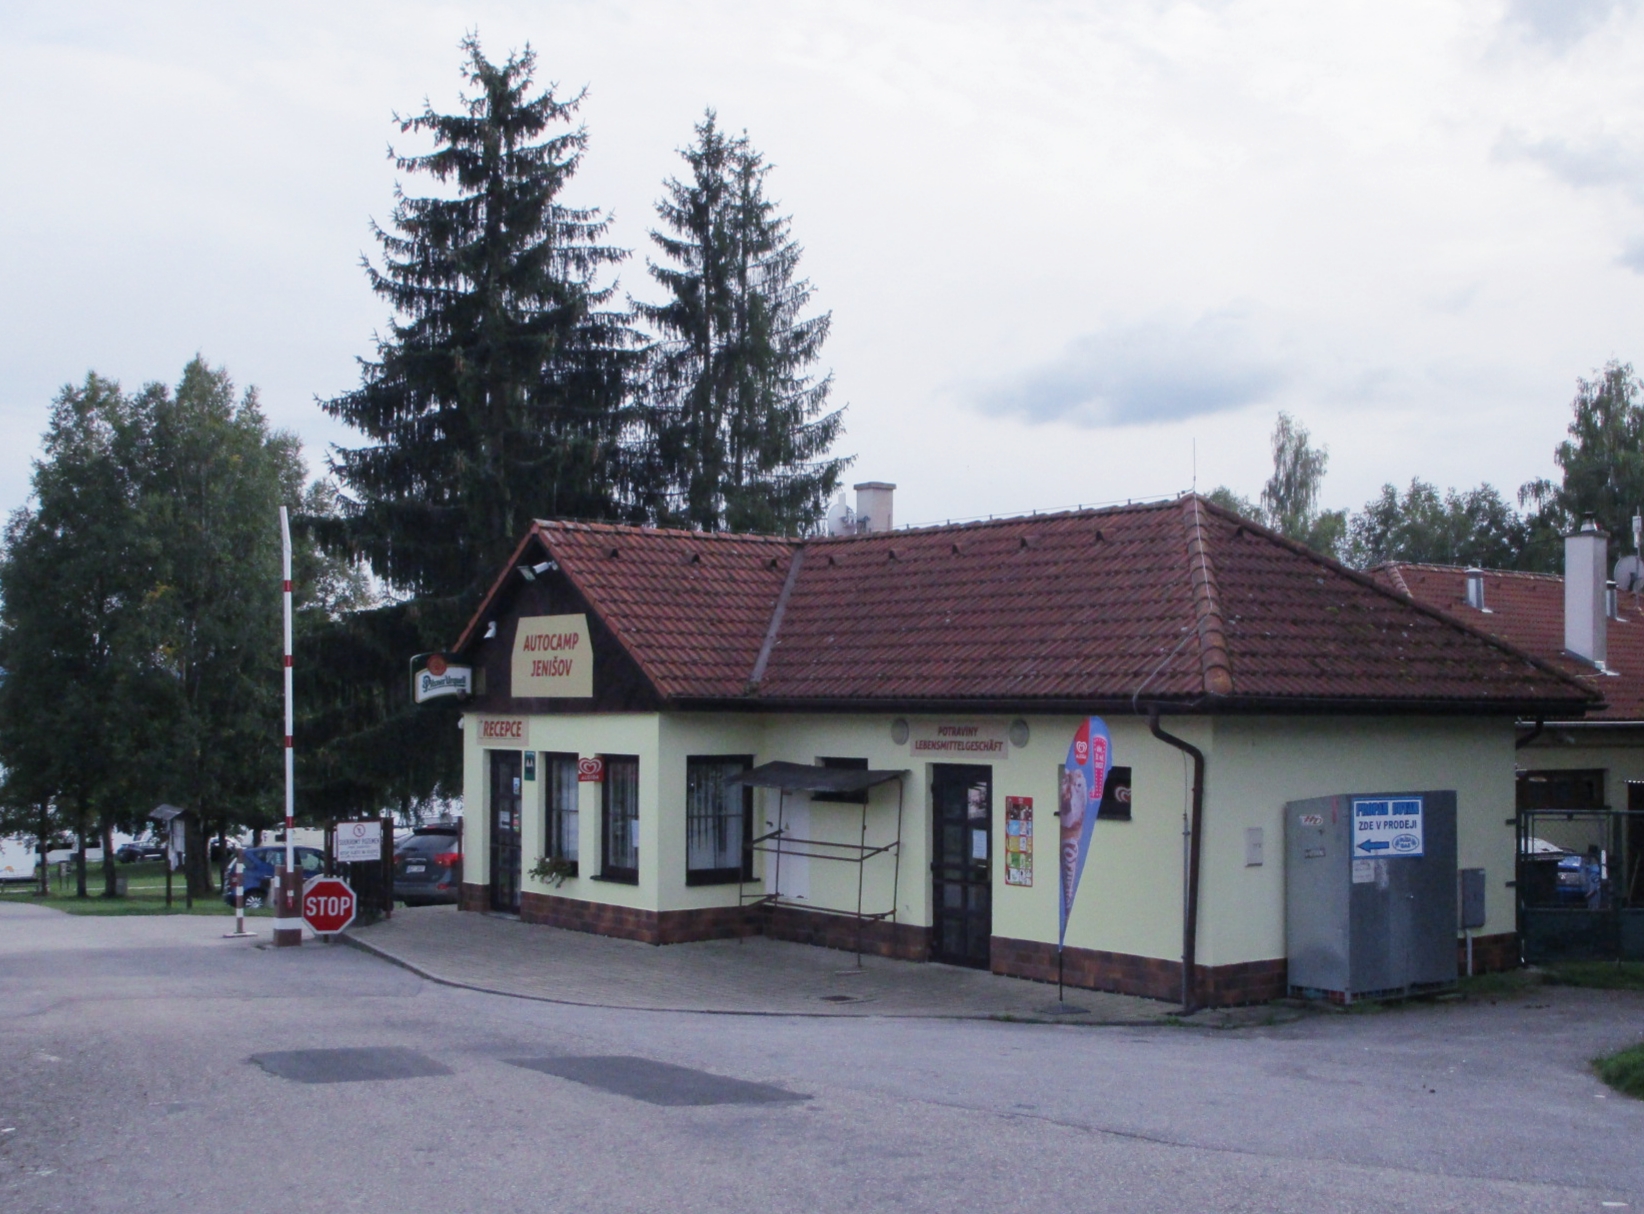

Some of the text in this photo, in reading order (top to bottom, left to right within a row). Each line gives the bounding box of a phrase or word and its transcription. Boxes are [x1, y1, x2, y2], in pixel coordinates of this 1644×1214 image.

[523, 633, 579, 651] AUTOCAMP
[531, 656, 573, 677] JENIŠOV
[483, 721, 522, 738] RECEPCE
[938, 726, 979, 736] POTRAVINY
[915, 739, 1004, 752] LEBENSMITTELGESCHÄFT
[1359, 819, 1417, 831] ZDE V PRODEJI
[306, 897, 351, 916] STOP
